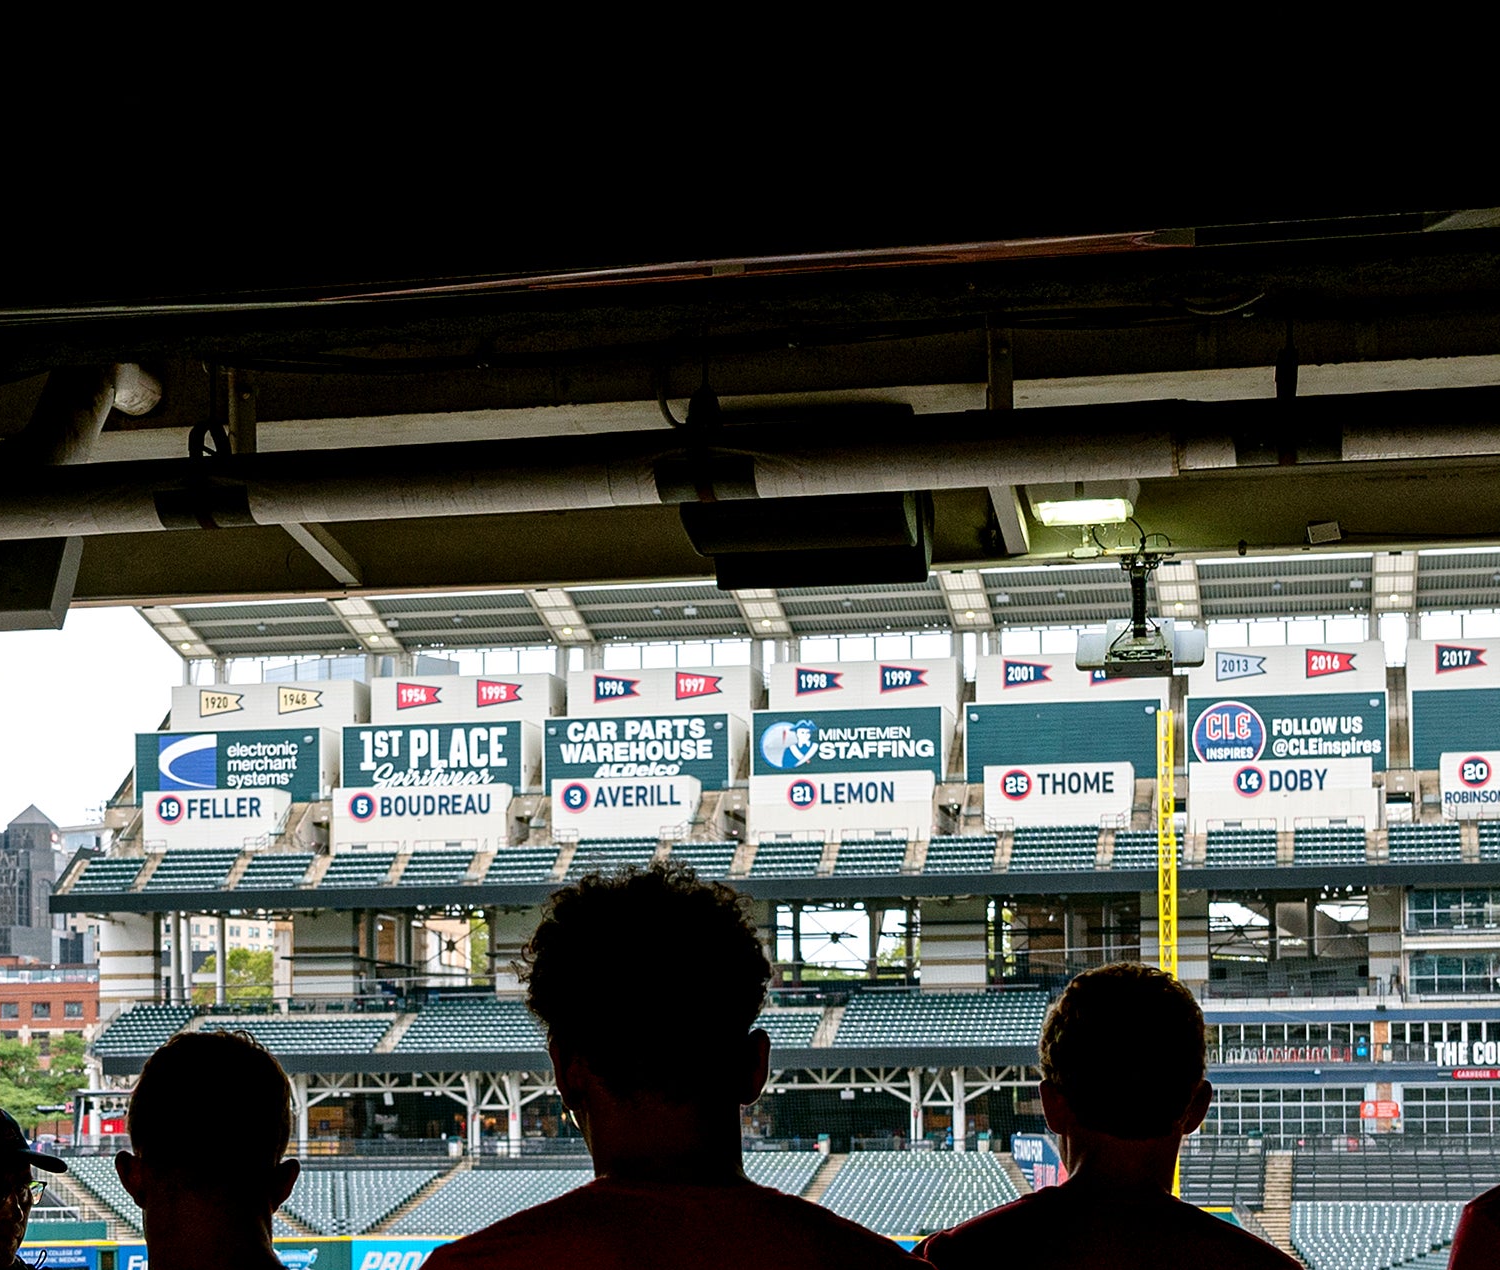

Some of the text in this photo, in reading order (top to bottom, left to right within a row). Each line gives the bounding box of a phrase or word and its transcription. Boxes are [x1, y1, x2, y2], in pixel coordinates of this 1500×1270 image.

[1221, 659, 1249, 673] 2013
[1311, 655, 1341, 671] 2016
[1442, 650, 1471, 666] 2017
[800, 674, 828, 689] 1998
[884, 671, 912, 686] 1999
[1007, 666, 1035, 682] 2001
[481, 686, 507, 700] 1995
[598, 681, 625, 695] 1996
[679, 678, 706, 692] 1997
[205, 697, 229, 710] 1920
[283, 694, 307, 706] 1948
[401, 689, 427, 703] 1954
[566, 717, 706, 743] CAR PARTS
[818, 726, 911, 742] MINUTEMEN
[1205, 711, 1251, 741] CLE
[1272, 716, 1363, 737] FOLLOW US
[226, 740, 299, 758] electronic
[359, 726, 508, 771] 1ST PLACE
[559, 738, 713, 764] WAREHOUSE
[818, 739, 935, 760] STAFFING
[1206, 746, 1254, 761] INSPIRES
[1272, 736, 1382, 757] @CLEinspires
[226, 755, 297, 772] merchant
[593, 762, 681, 778] ACDelco
[1462, 763, 1488, 781] 20
[372, 762, 495, 790] Spiritwear
[1005, 771, 1114, 795] 25 THOME
[1238, 768, 1328, 792] 14 DOBY
[569, 785, 681, 808] 3 AVERILL
[792, 781, 895, 805] 21 LEMON
[160, 797, 261, 819] 19 FELLER
[356, 793, 491, 817] 5 BOUDREAU
[1434, 1042, 1468, 1067] THE
